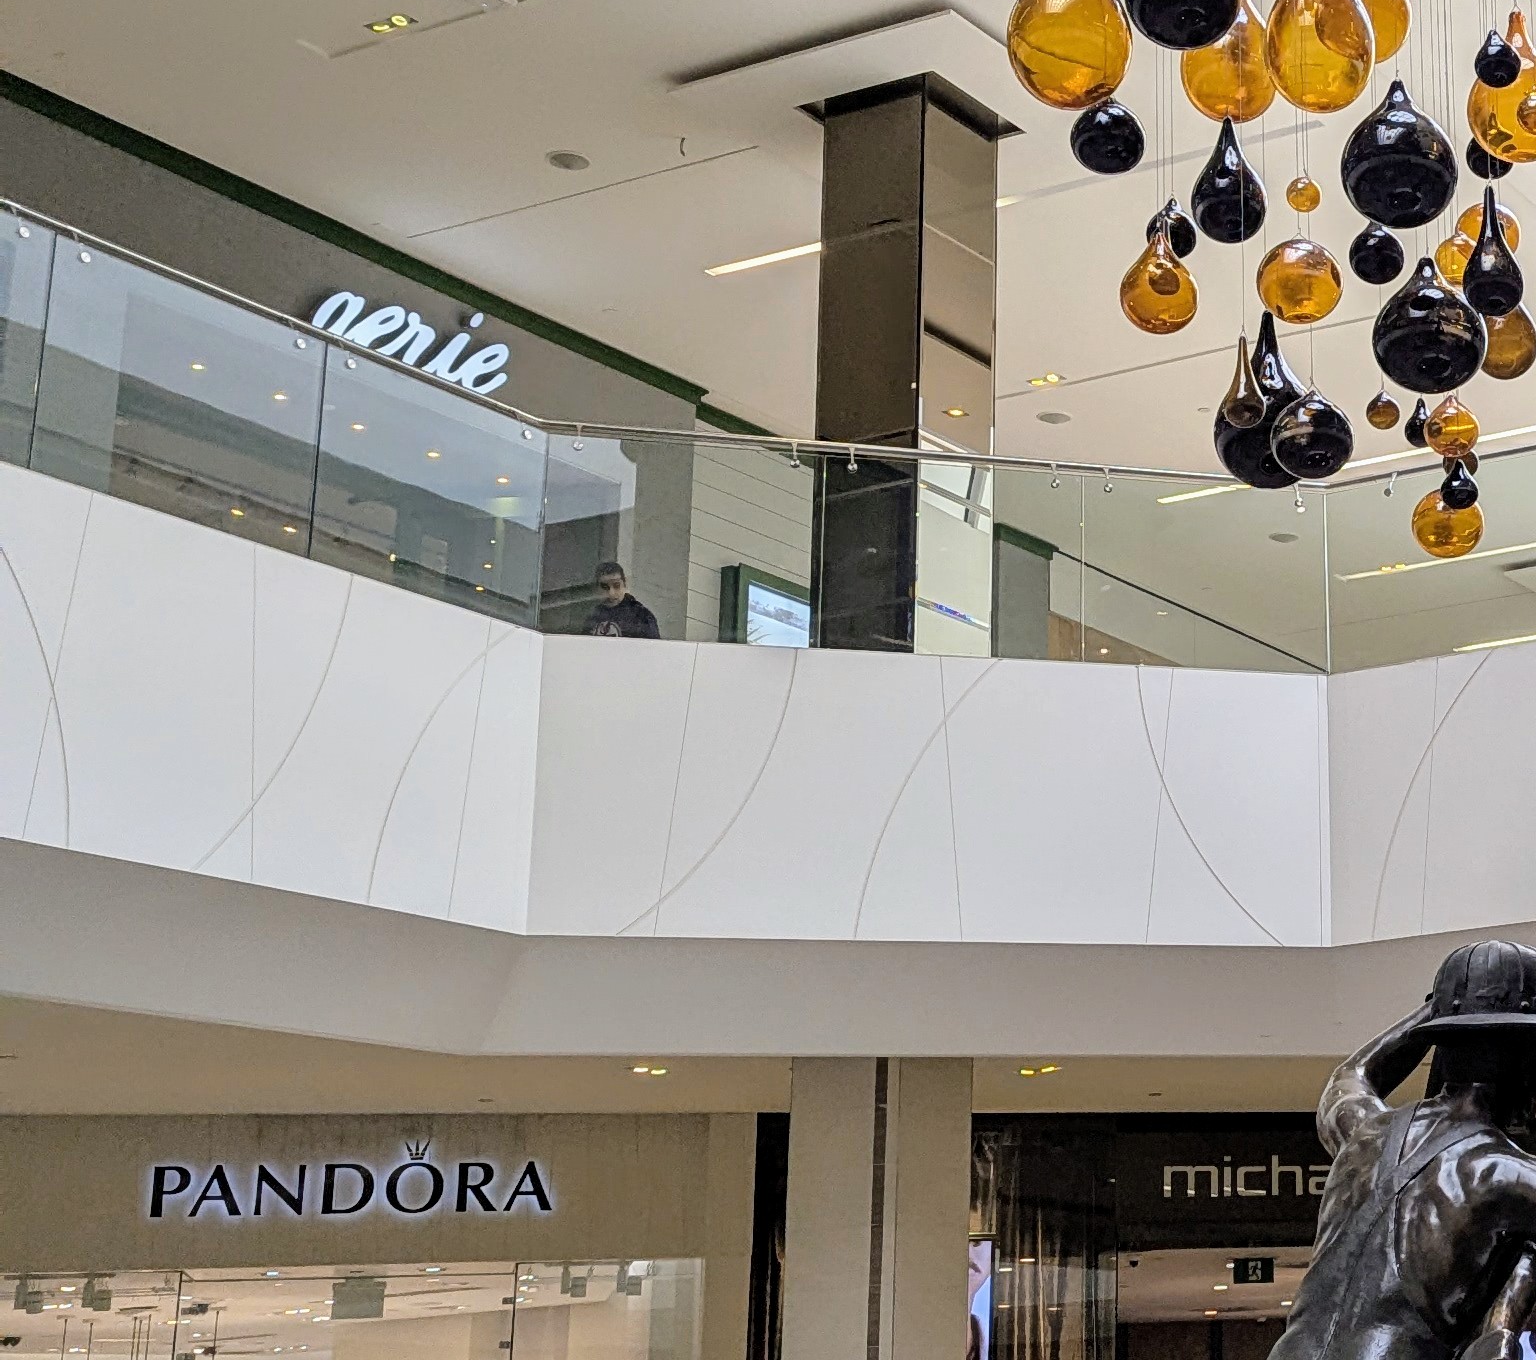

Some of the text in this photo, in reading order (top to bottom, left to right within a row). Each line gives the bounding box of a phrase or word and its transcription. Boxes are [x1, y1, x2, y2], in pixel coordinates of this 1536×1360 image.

[311, 291, 510, 395] aerie
[149, 1160, 553, 1218] PANDORA
[1163, 1154, 1333, 1198] micha
